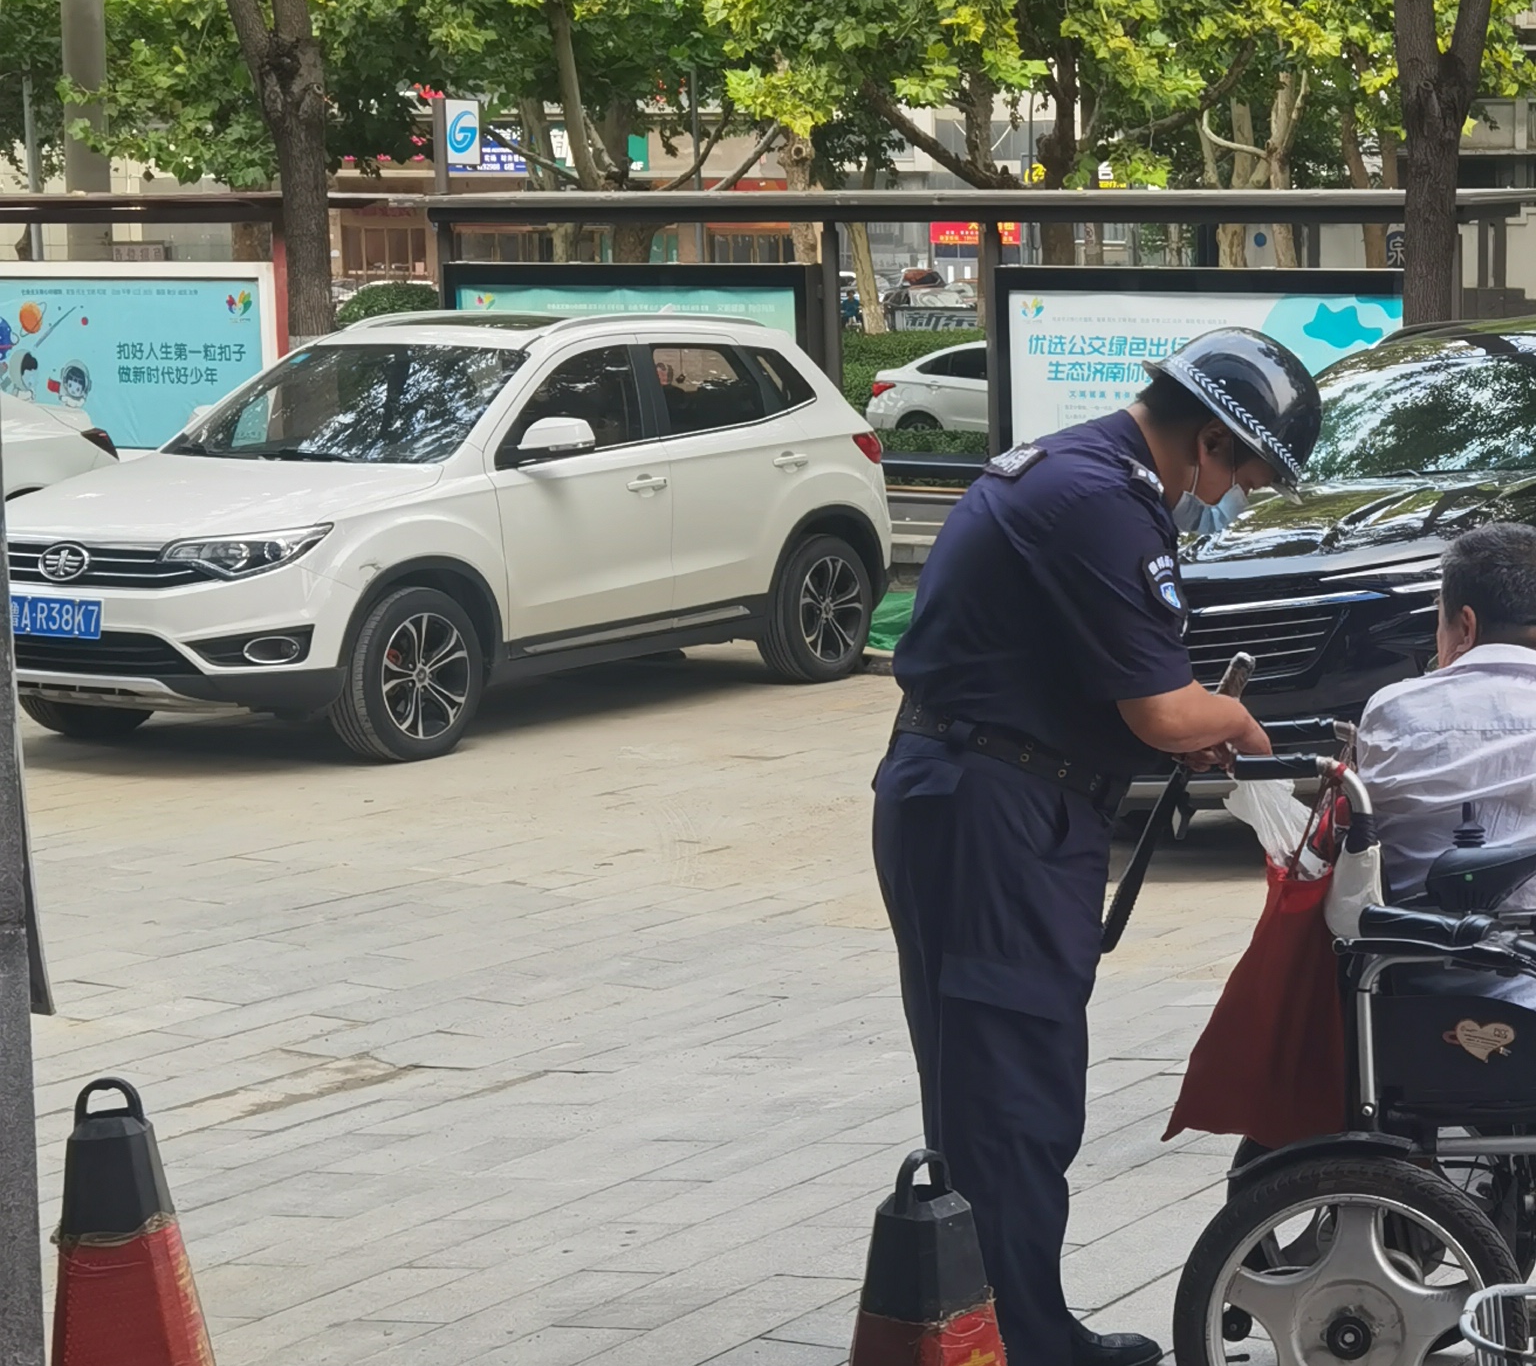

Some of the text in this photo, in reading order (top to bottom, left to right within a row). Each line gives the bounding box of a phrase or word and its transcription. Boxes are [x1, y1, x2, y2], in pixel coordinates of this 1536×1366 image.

[116, 341, 247, 362] 扣好人生第一粒扣子
[117, 366, 219, 385] 做新时代好少年
[1046, 360, 1153, 384] 生态济南你
